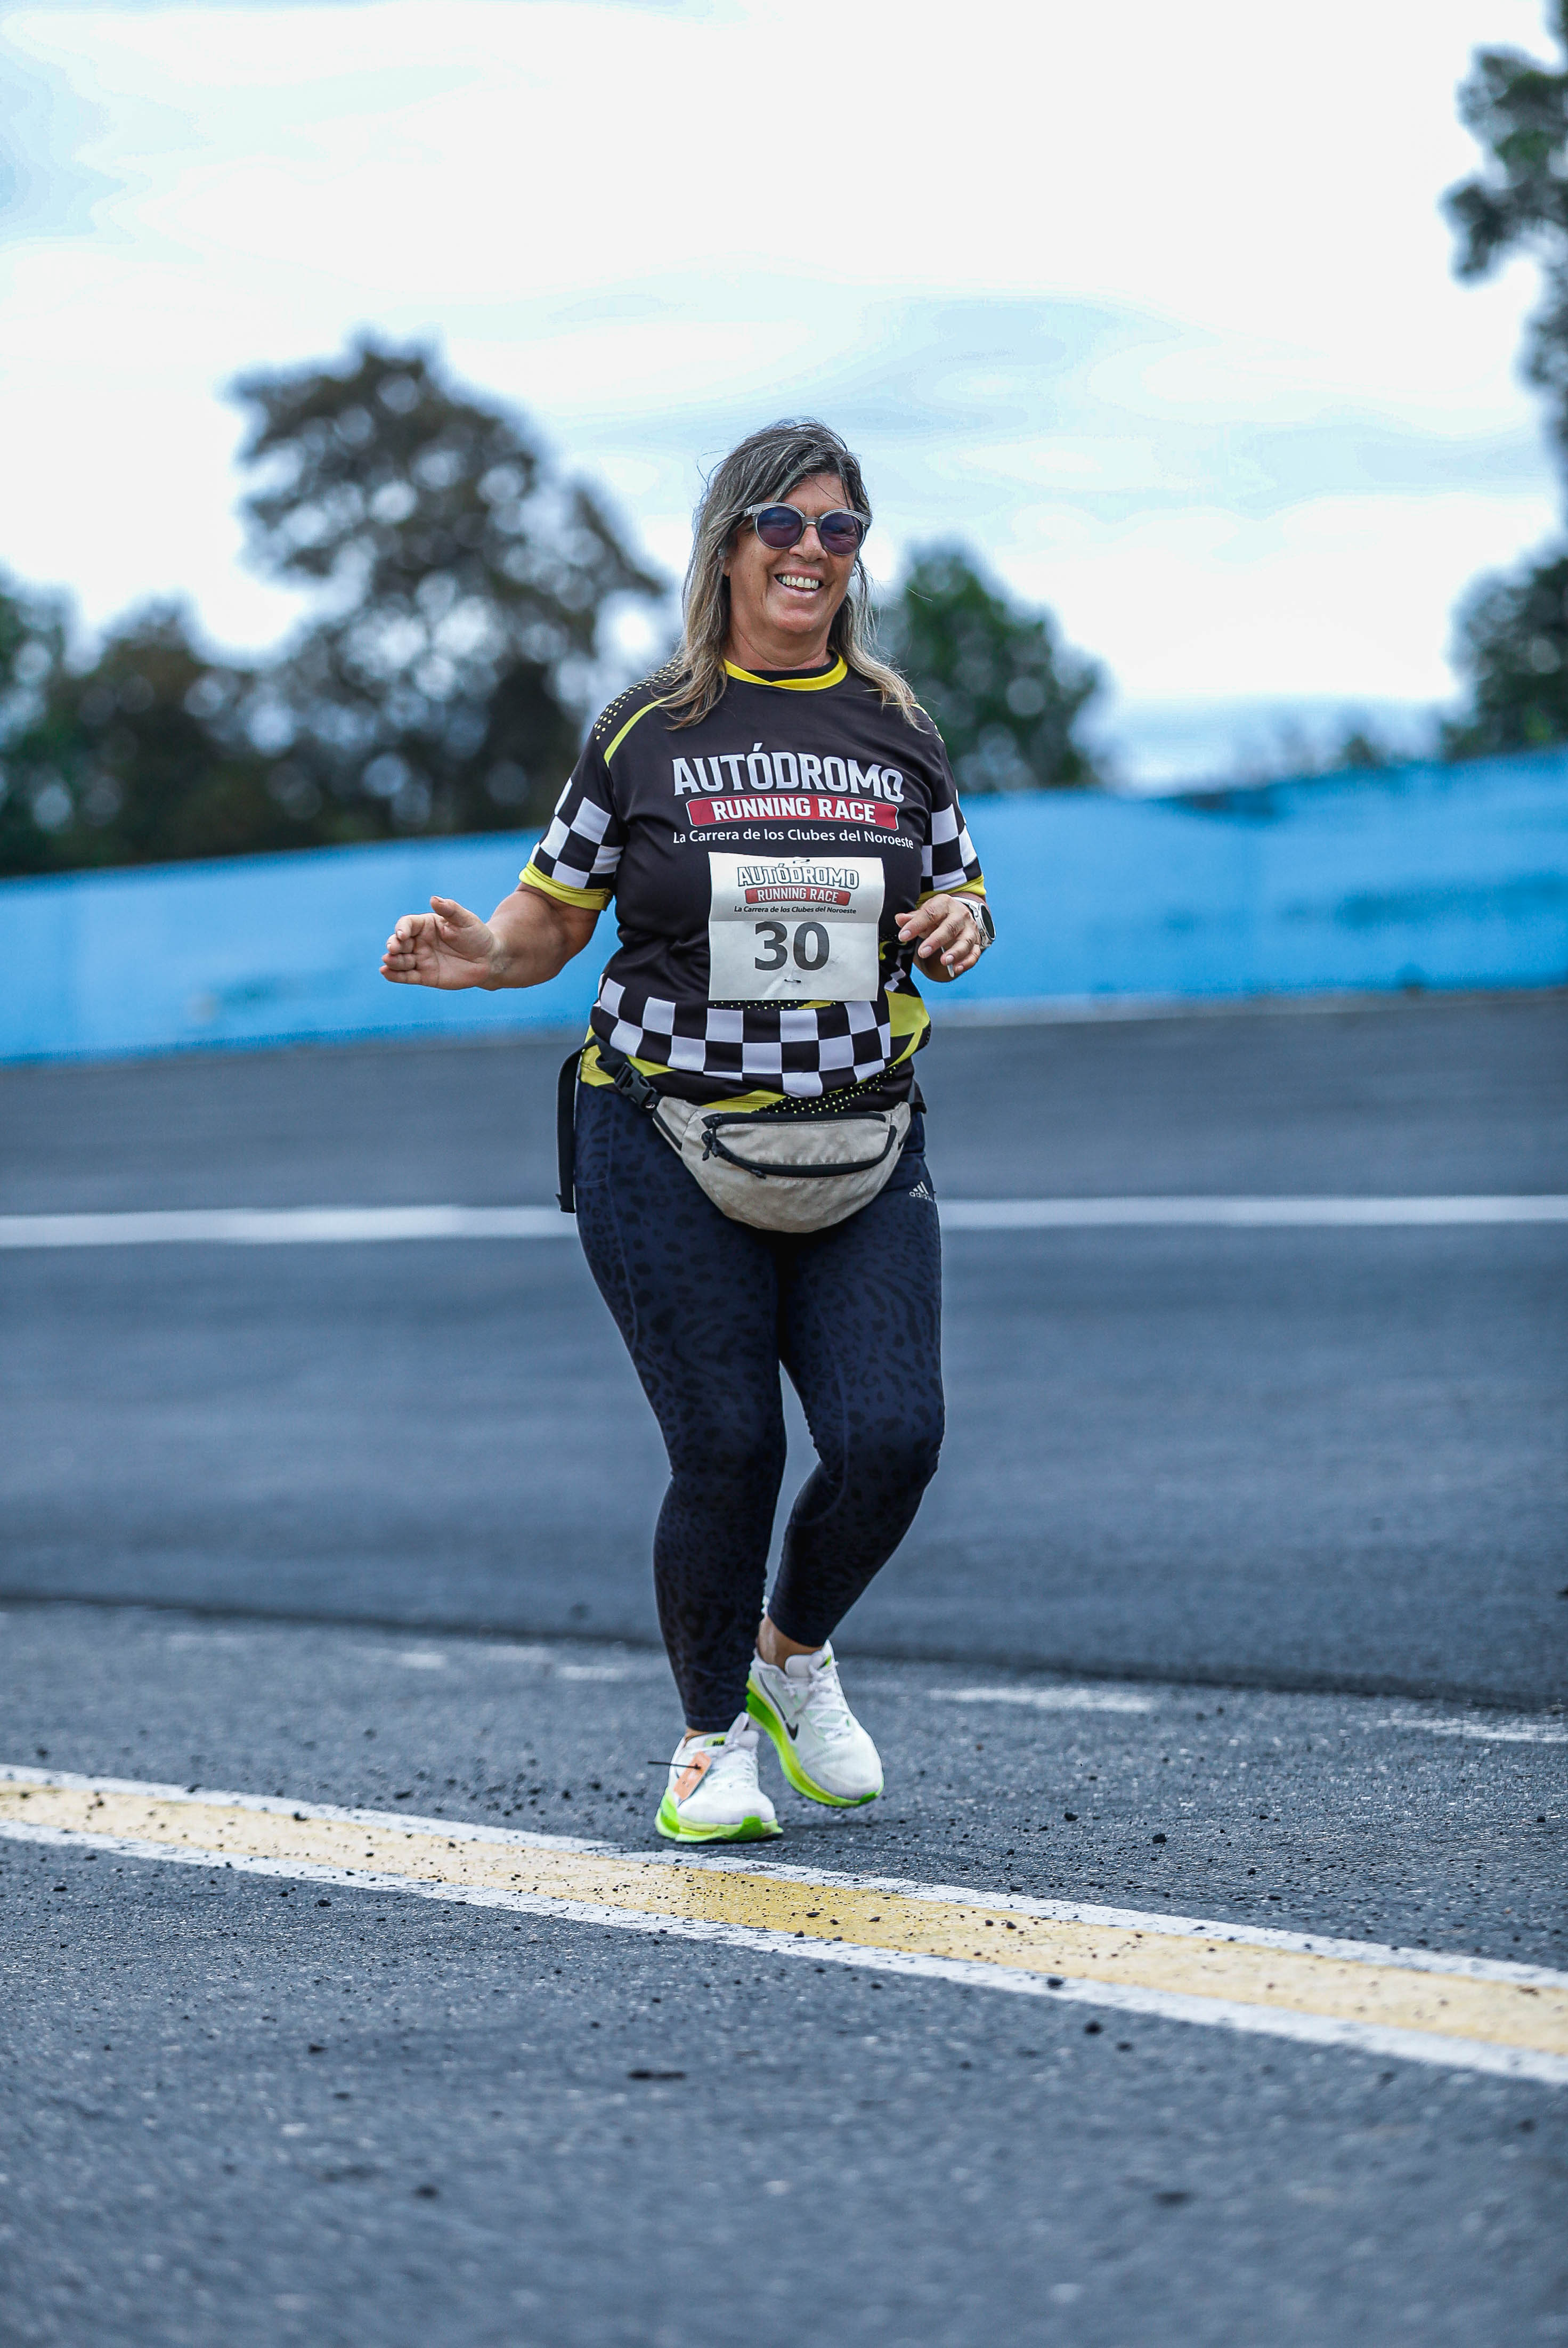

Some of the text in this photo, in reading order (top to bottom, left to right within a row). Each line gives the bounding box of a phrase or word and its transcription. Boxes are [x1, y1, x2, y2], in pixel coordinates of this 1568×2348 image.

[672, 743, 905, 802] AUTÓDROMO
[711, 797, 876, 824] RUNNING RACE
[673, 828, 914, 849] La Carrera de los Clubes del Noroeste
[737, 863, 859, 889] AUTÓDROMO
[757, 888, 839, 903] RUNNING RACE
[754, 921, 830, 971] 30
